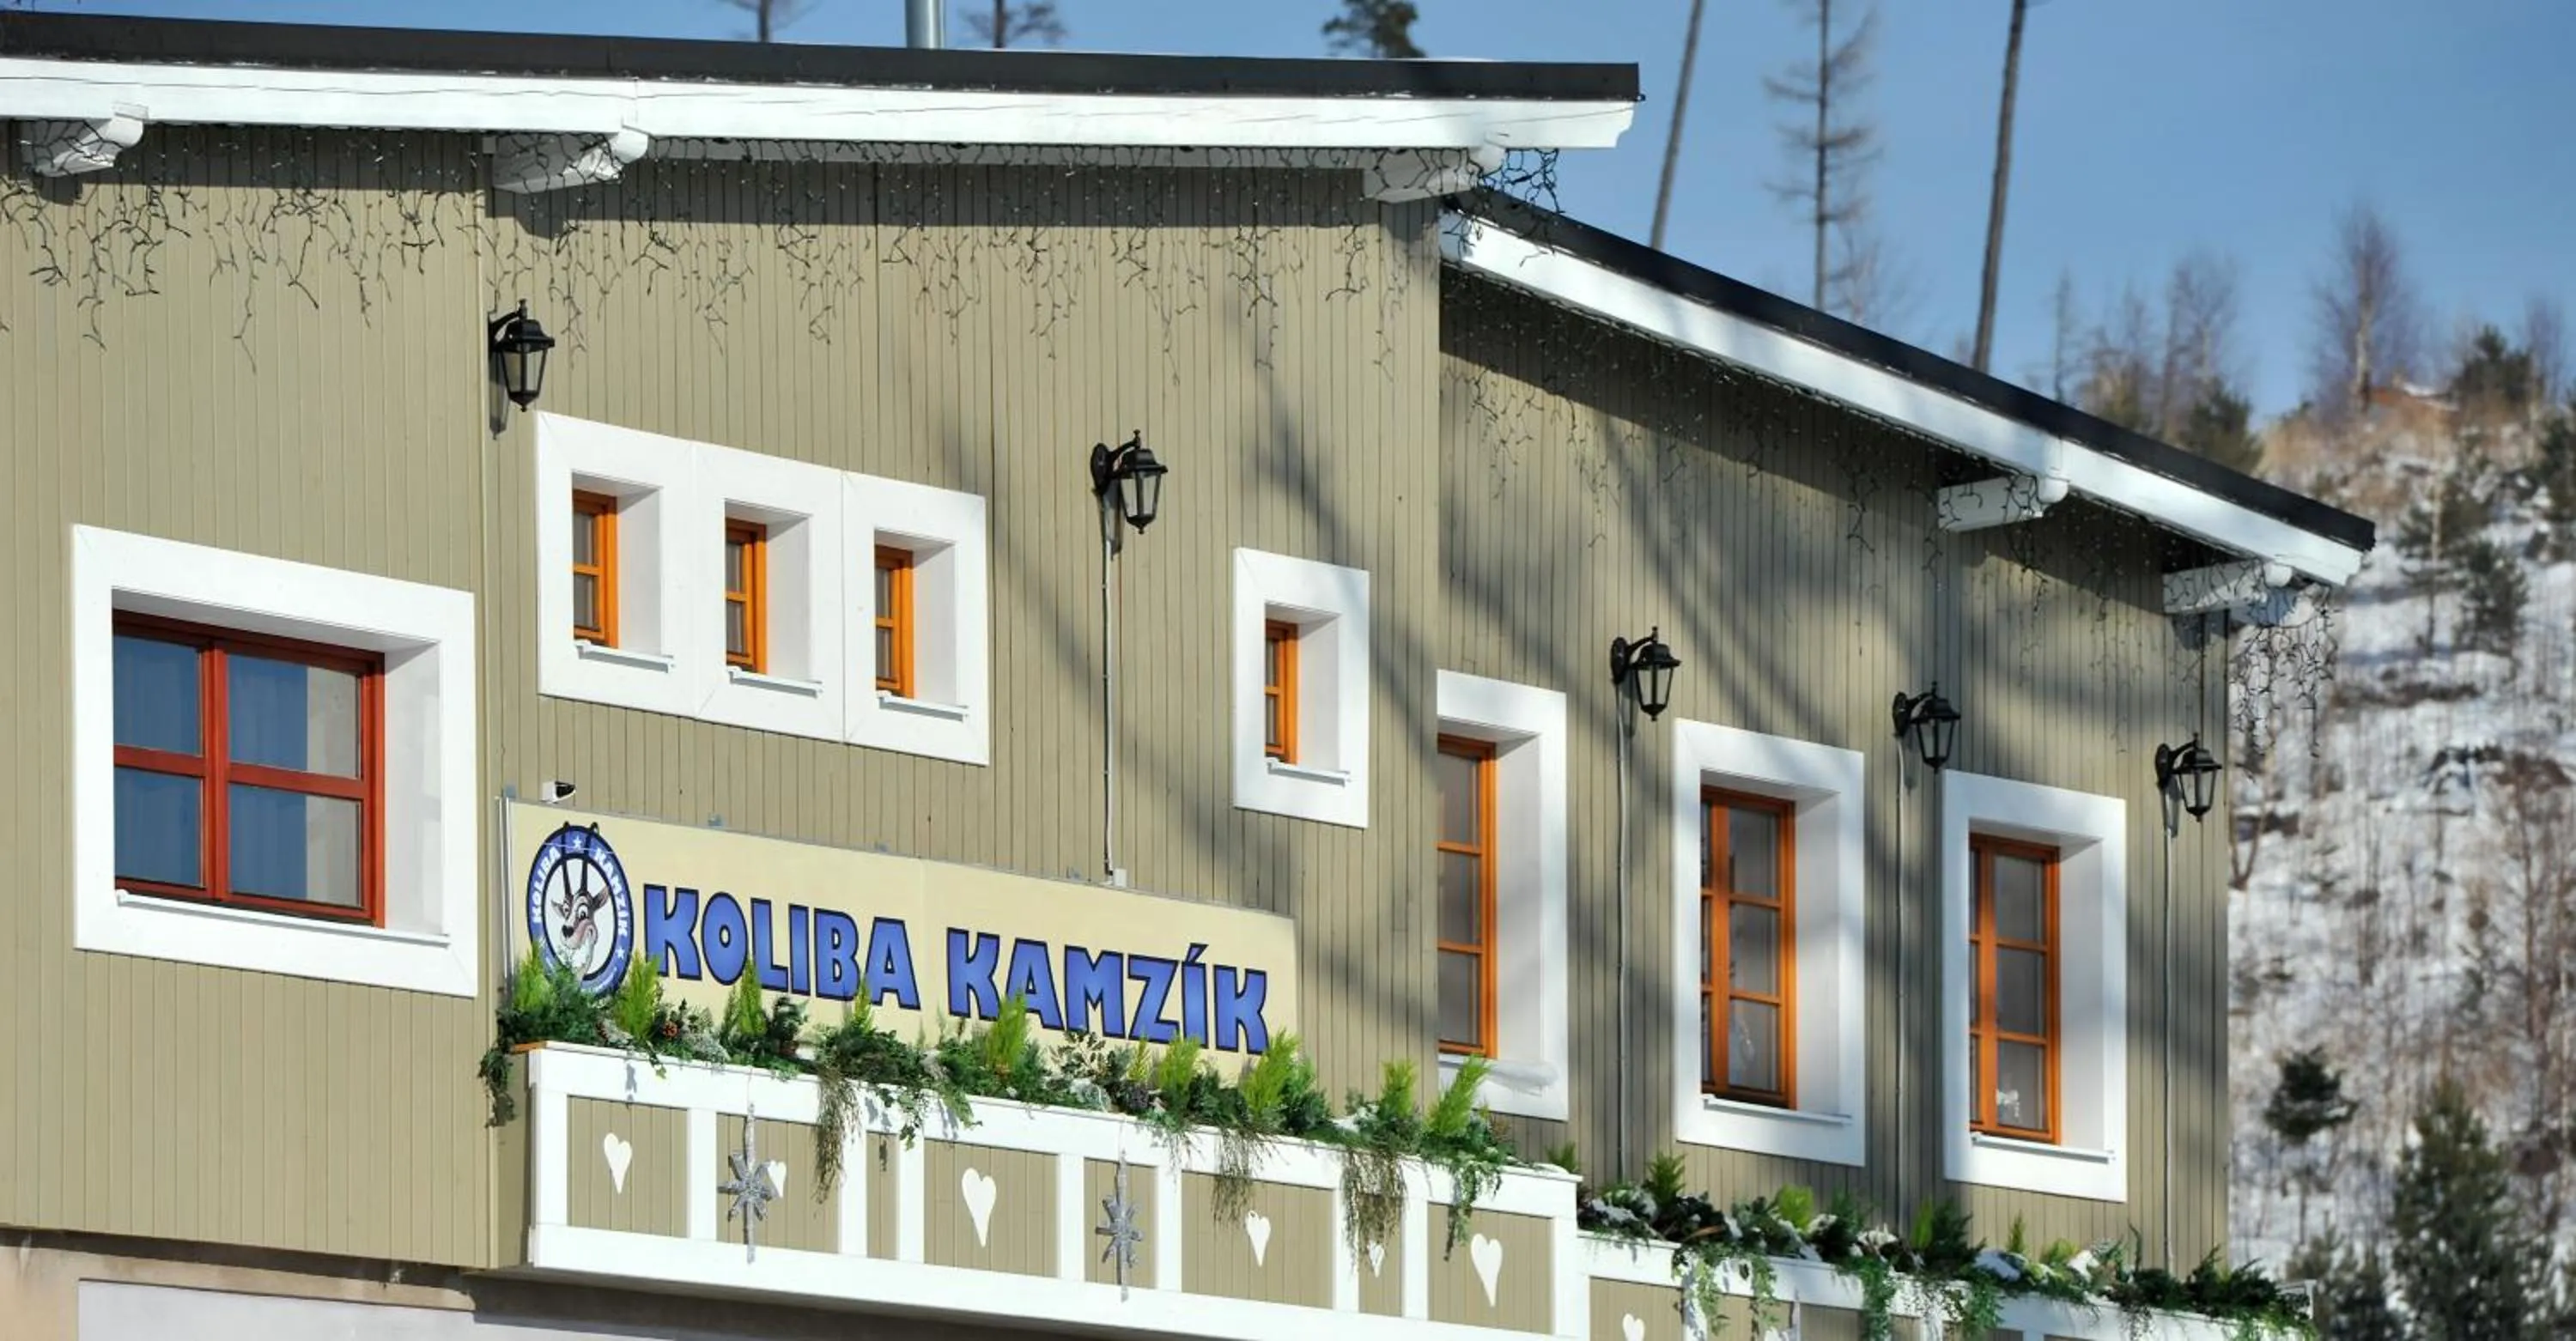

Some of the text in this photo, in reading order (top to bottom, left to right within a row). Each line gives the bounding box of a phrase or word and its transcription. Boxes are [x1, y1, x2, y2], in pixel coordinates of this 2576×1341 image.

[532, 846, 561, 923] KOLIBA
[643, 883, 1269, 1055] KOLIBA KAMZÍK
